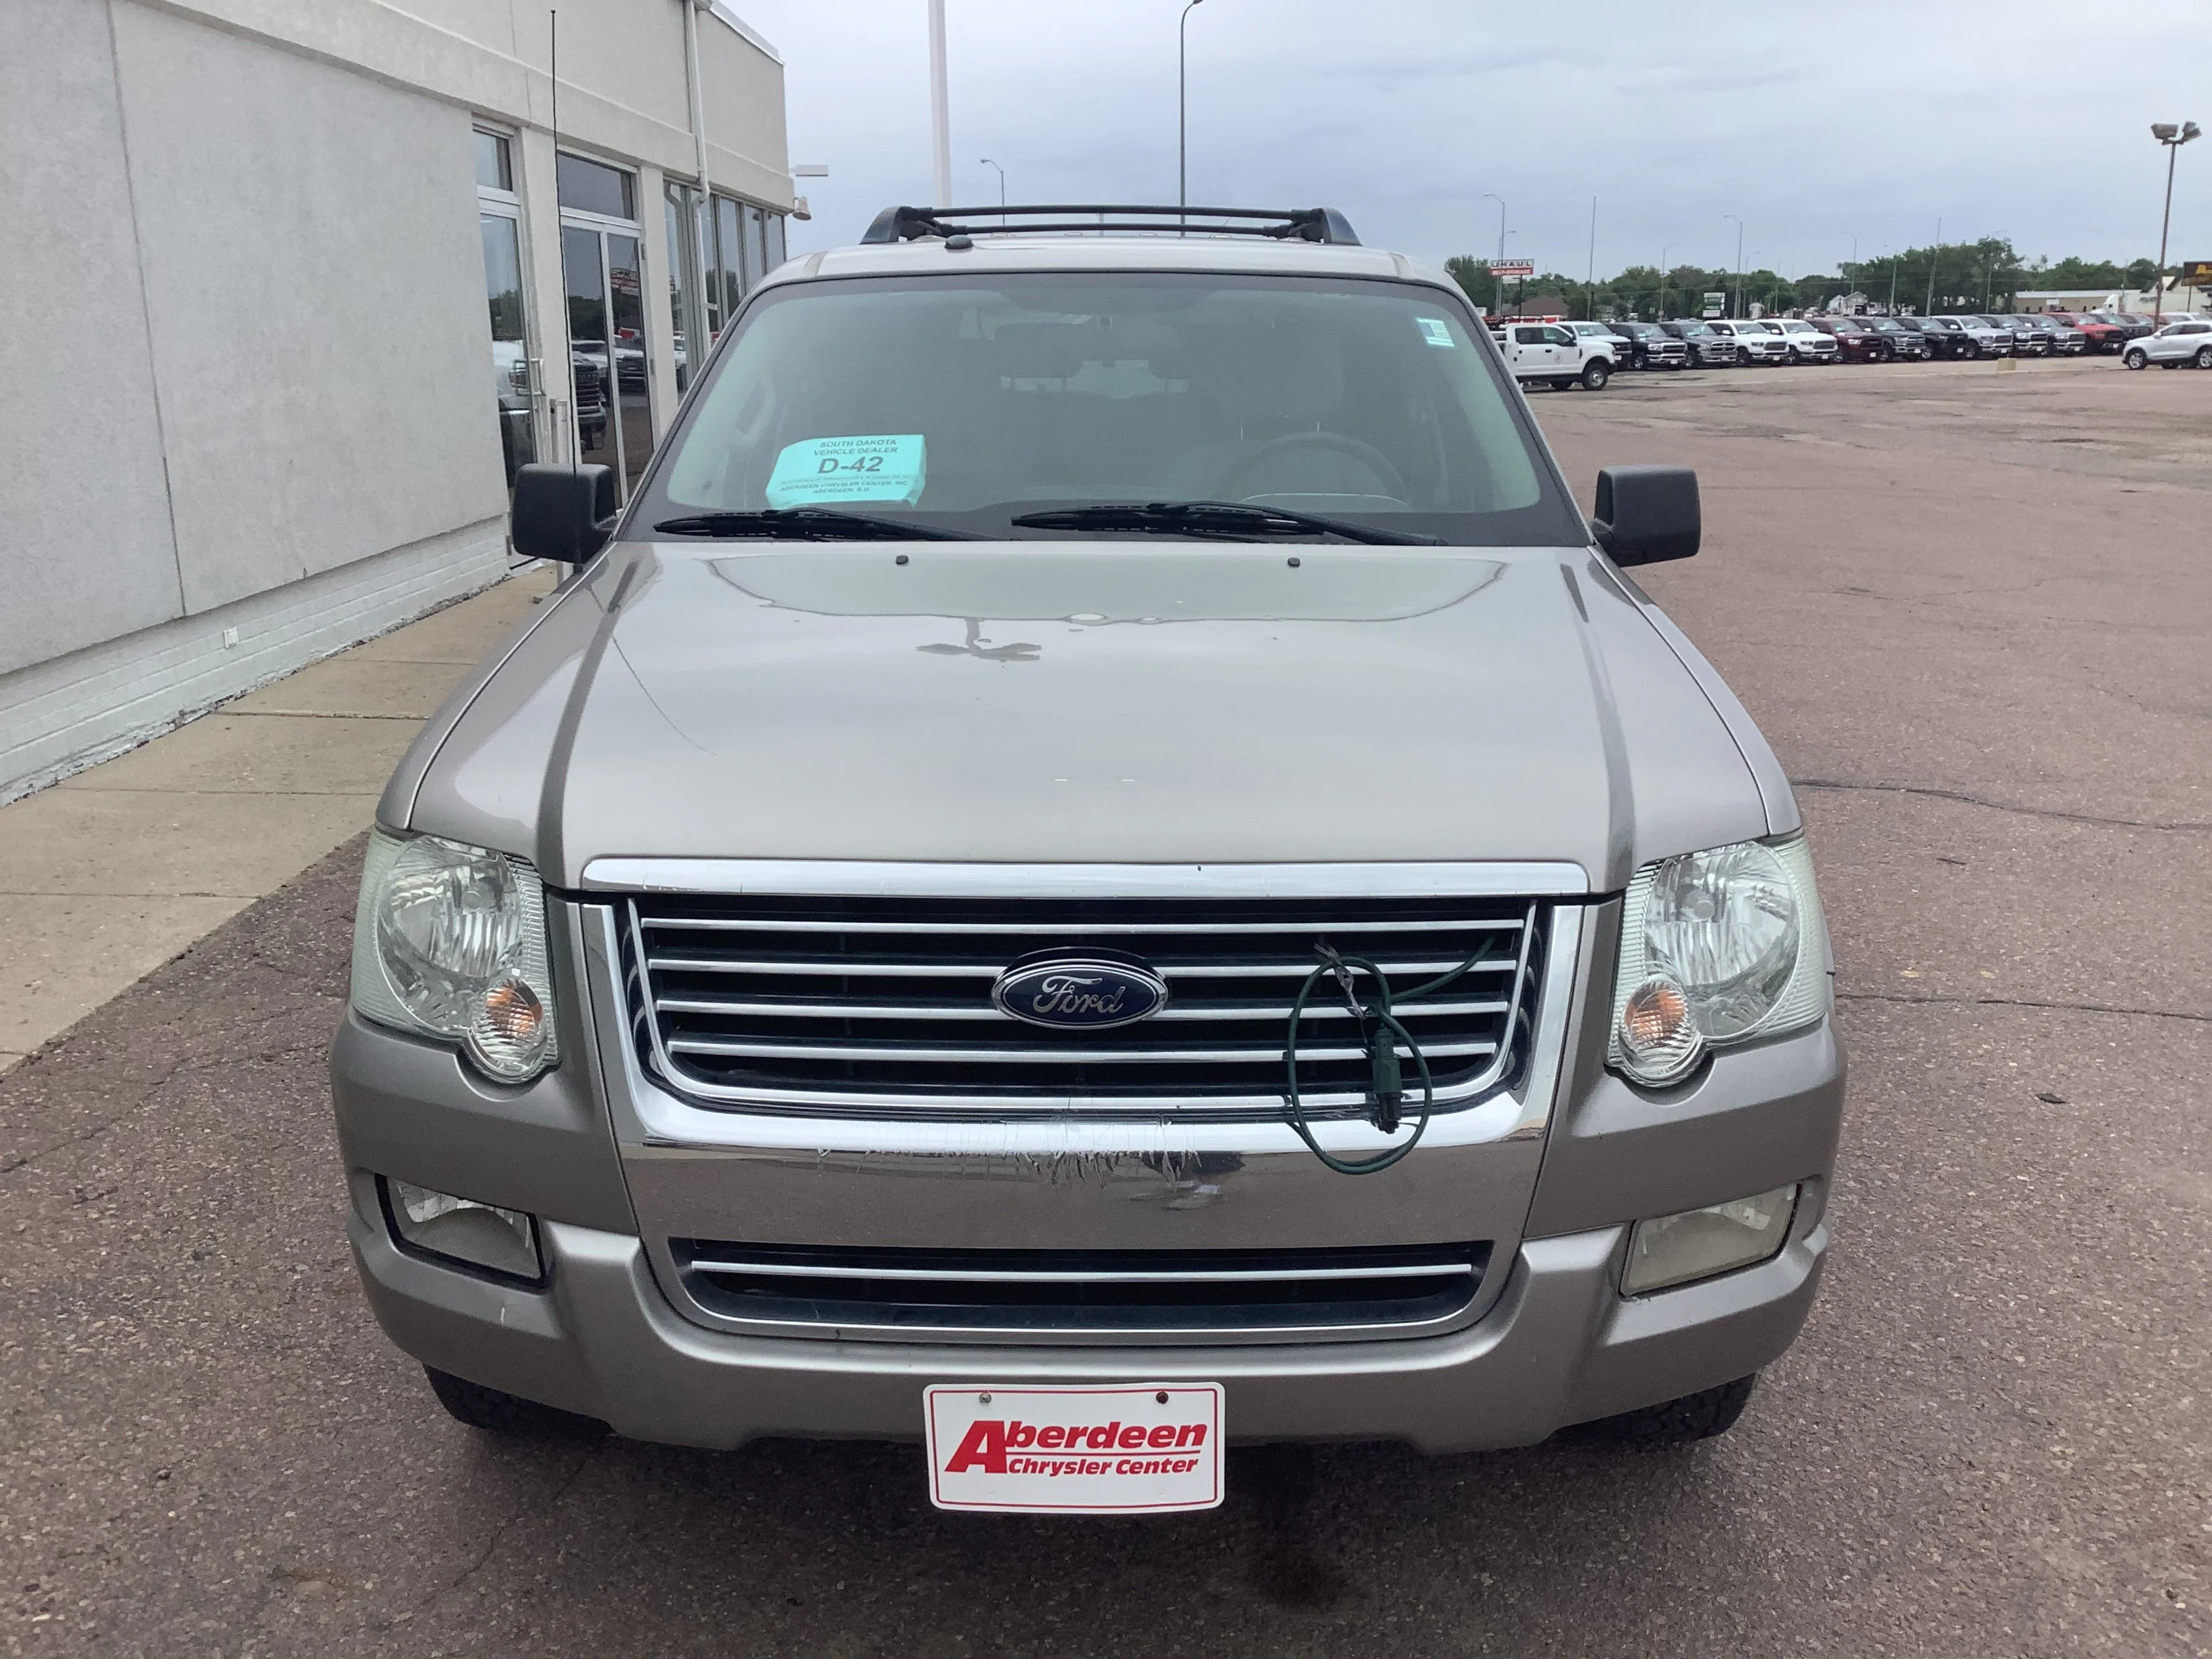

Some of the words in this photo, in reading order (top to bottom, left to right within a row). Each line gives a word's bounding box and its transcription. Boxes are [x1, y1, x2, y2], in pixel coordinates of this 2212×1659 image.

[817, 456, 884, 474] D-42
[780, 483, 819, 491] ABERDEEN
[1032, 975, 1126, 1014] Ford
[944, 1420, 1208, 1474] Aberdeen
[1008, 1458, 1113, 1477] Chrysler
[1115, 1458, 1199, 1475] Center
